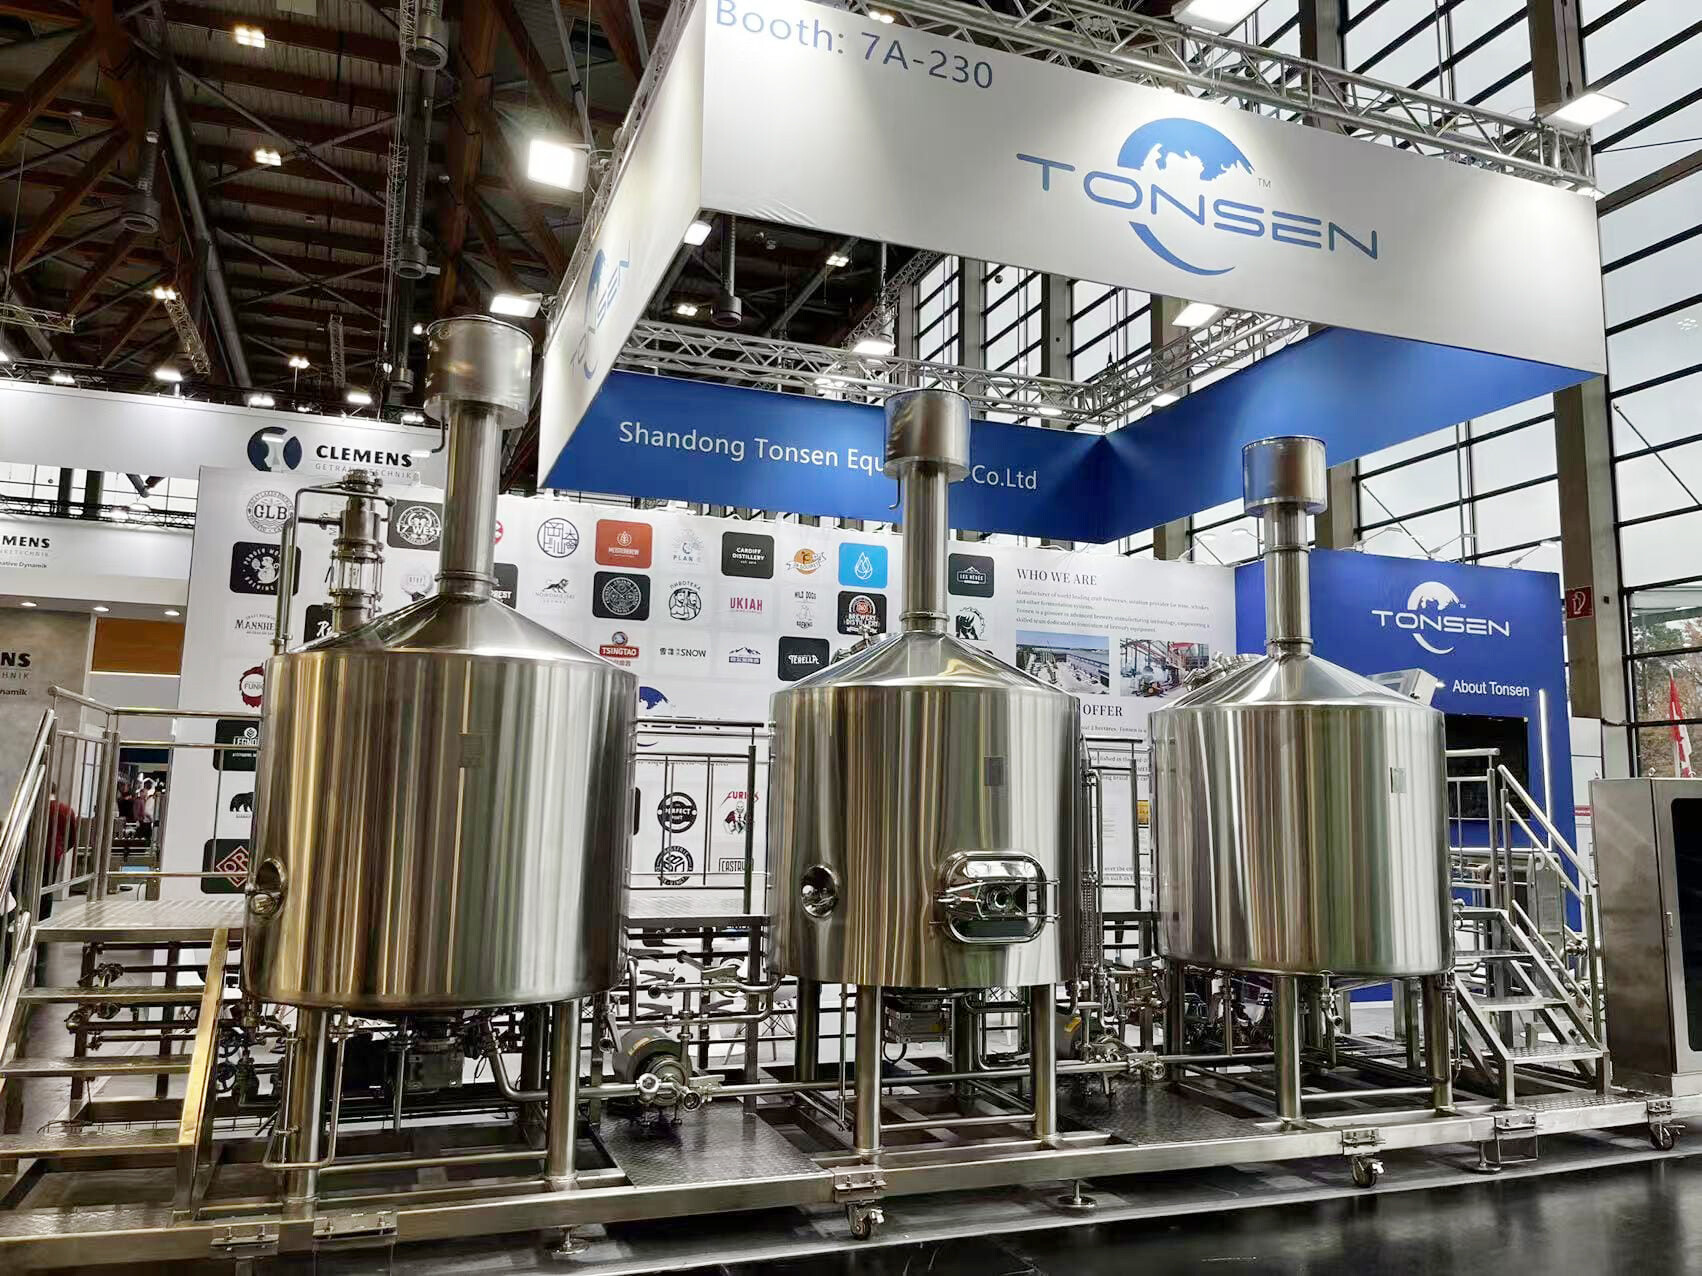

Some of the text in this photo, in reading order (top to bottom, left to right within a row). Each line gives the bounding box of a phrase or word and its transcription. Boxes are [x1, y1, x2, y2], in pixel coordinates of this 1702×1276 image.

[716, 0, 993, 89] Booth: 7A-230
[1016, 152, 1378, 260] TONSEN
[316, 445, 412, 468] CLEMENS
[618, 421, 746, 463] Shandong
[754, 437, 839, 468] Tonsen
[971, 464, 1038, 490] Co.Ltd
[254, 504, 288, 521] GLB
[412, 525, 442, 538] WEST
[732, 553, 765, 561] DISTILLERY
[736, 547, 762, 555] CARDIFF
[1016, 567, 1097, 586] WHO WE ARE
[730, 597, 763, 612] UKIAH
[234, 619, 275, 631] MANNHE
[1371, 609, 1511, 637] TONSEN
[601, 647, 637, 657] TSINGTAO
[681, 648, 707, 657] SNOW
[1452, 679, 1530, 697] About Tonsen
[1082, 704, 1123, 717] OFFER
